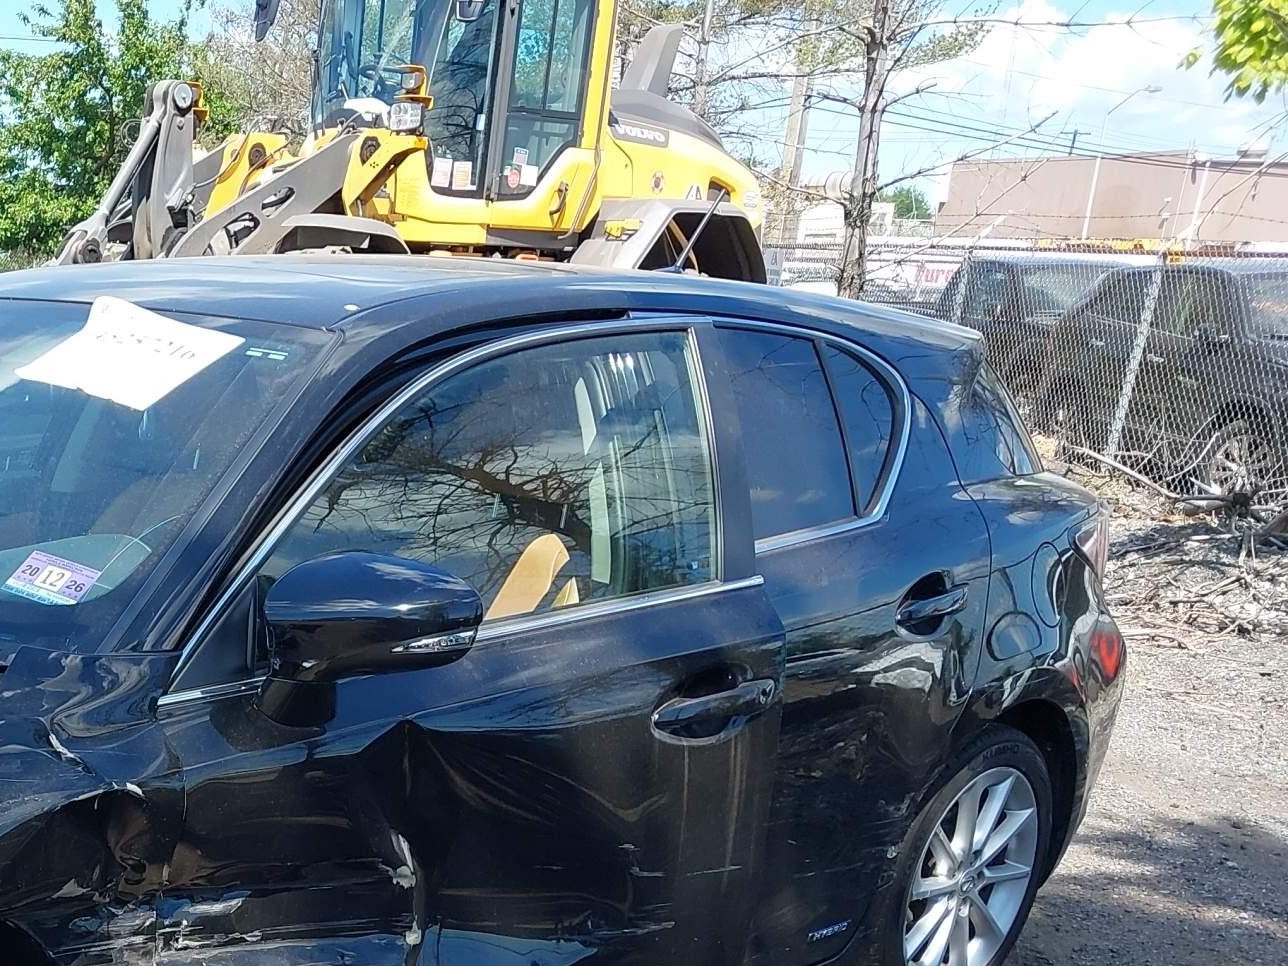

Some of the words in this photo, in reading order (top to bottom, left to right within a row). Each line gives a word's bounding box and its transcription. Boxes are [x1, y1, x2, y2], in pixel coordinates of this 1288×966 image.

[21, 564, 41, 577] 20
[39, 570, 66, 588] 12
[65, 580, 86, 593] 26
